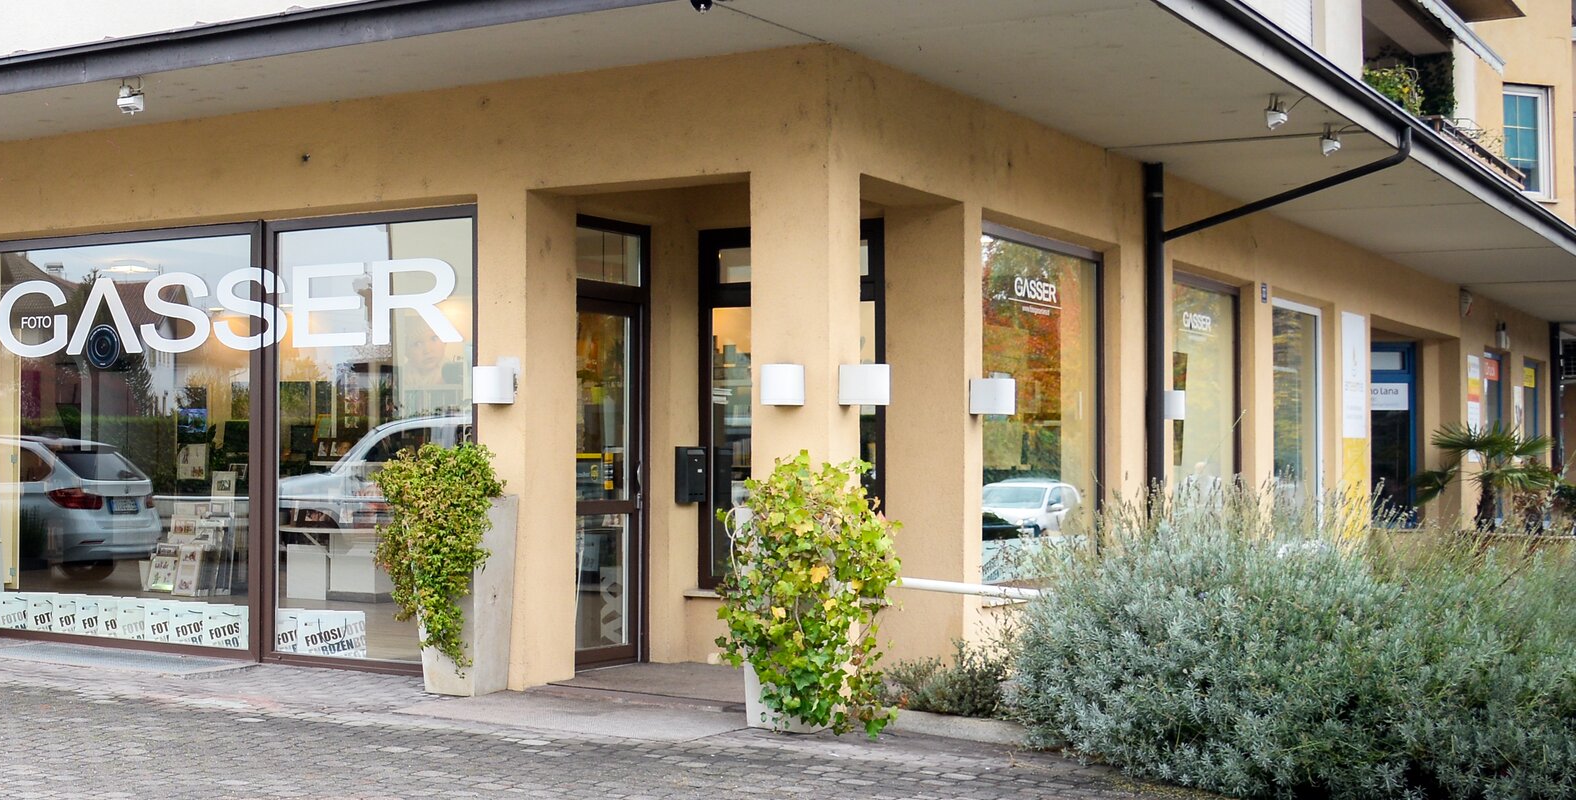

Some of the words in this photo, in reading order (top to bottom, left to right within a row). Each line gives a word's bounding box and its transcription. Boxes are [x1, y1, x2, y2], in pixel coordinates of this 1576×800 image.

[1014, 276, 1057, 304] GASSER
[21, 315, 52, 329] FOTO
[1182, 311, 1212, 332] GASSER
[34, 611, 53, 626] FOT
